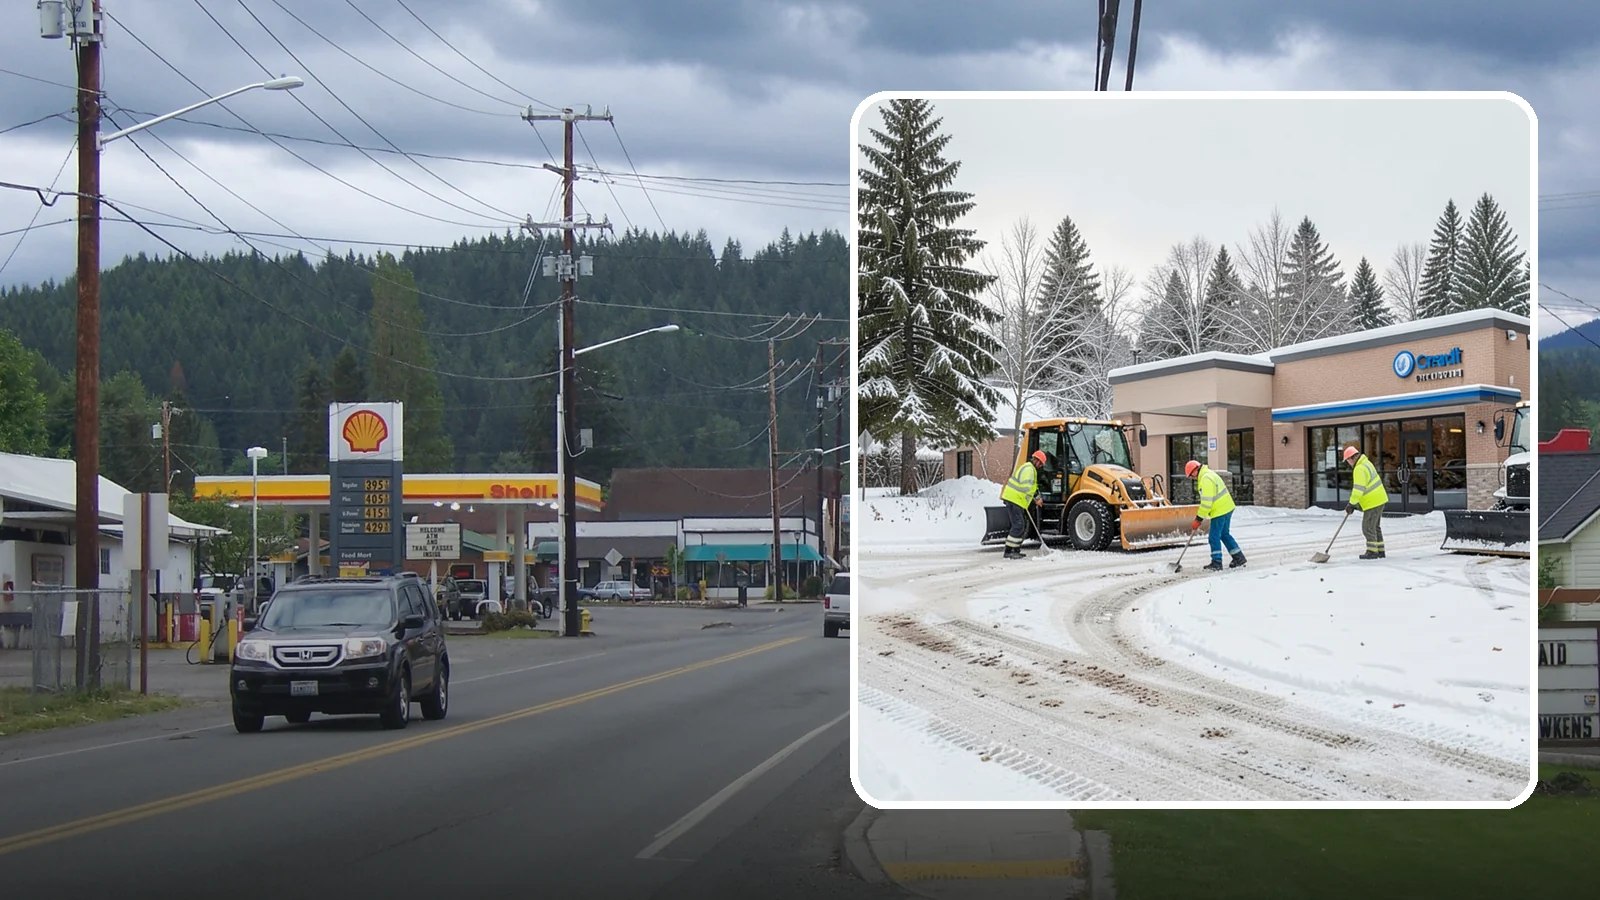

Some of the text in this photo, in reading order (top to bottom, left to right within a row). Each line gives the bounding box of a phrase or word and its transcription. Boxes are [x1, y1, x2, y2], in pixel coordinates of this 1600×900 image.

[366, 479, 383, 490] 395
[490, 484, 547, 499] Shell
[366, 493, 383, 504] 405
[366, 507, 383, 518] 415
[366, 522, 383, 532] 429
